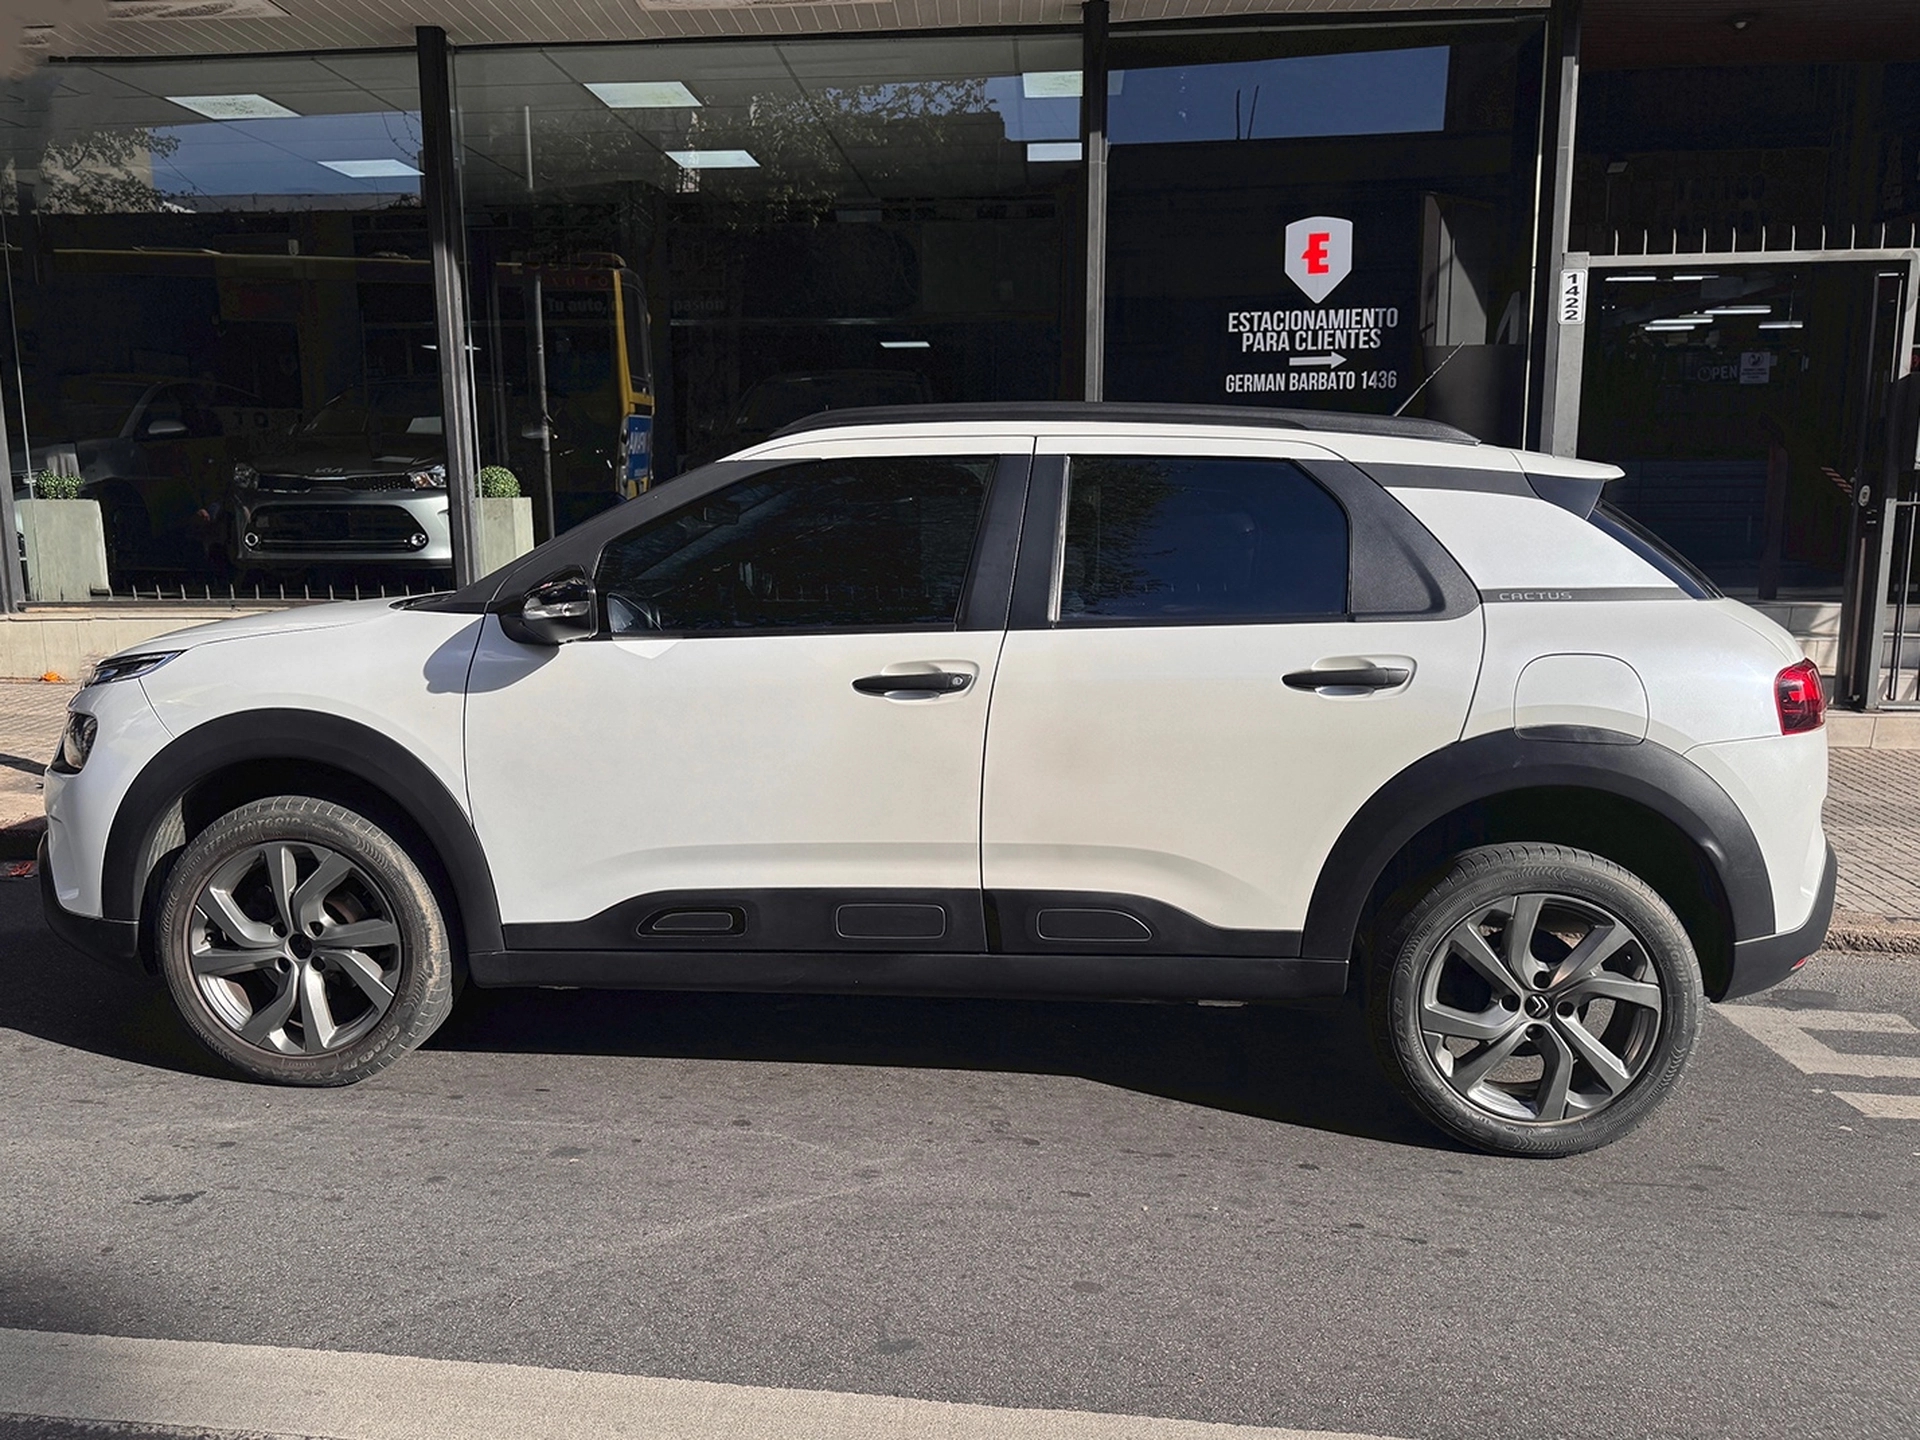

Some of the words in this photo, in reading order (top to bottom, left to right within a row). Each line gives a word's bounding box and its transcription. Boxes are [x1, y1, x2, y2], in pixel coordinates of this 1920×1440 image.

[1302, 232, 1330, 274] E
[1564, 273, 1580, 321] 1422
[1228, 307, 1399, 333] ESTACIONAMIENTO
[1241, 330, 1290, 353] PARA
[1295, 327, 1382, 351] CLIENTES
[1225, 373, 1285, 393] GERMAN
[1289, 371, 1356, 391] BARBATO
[1361, 370, 1397, 389] 1436
[1697, 365, 1738, 382] OPEN
[1499, 591, 1572, 601] CACTUS
